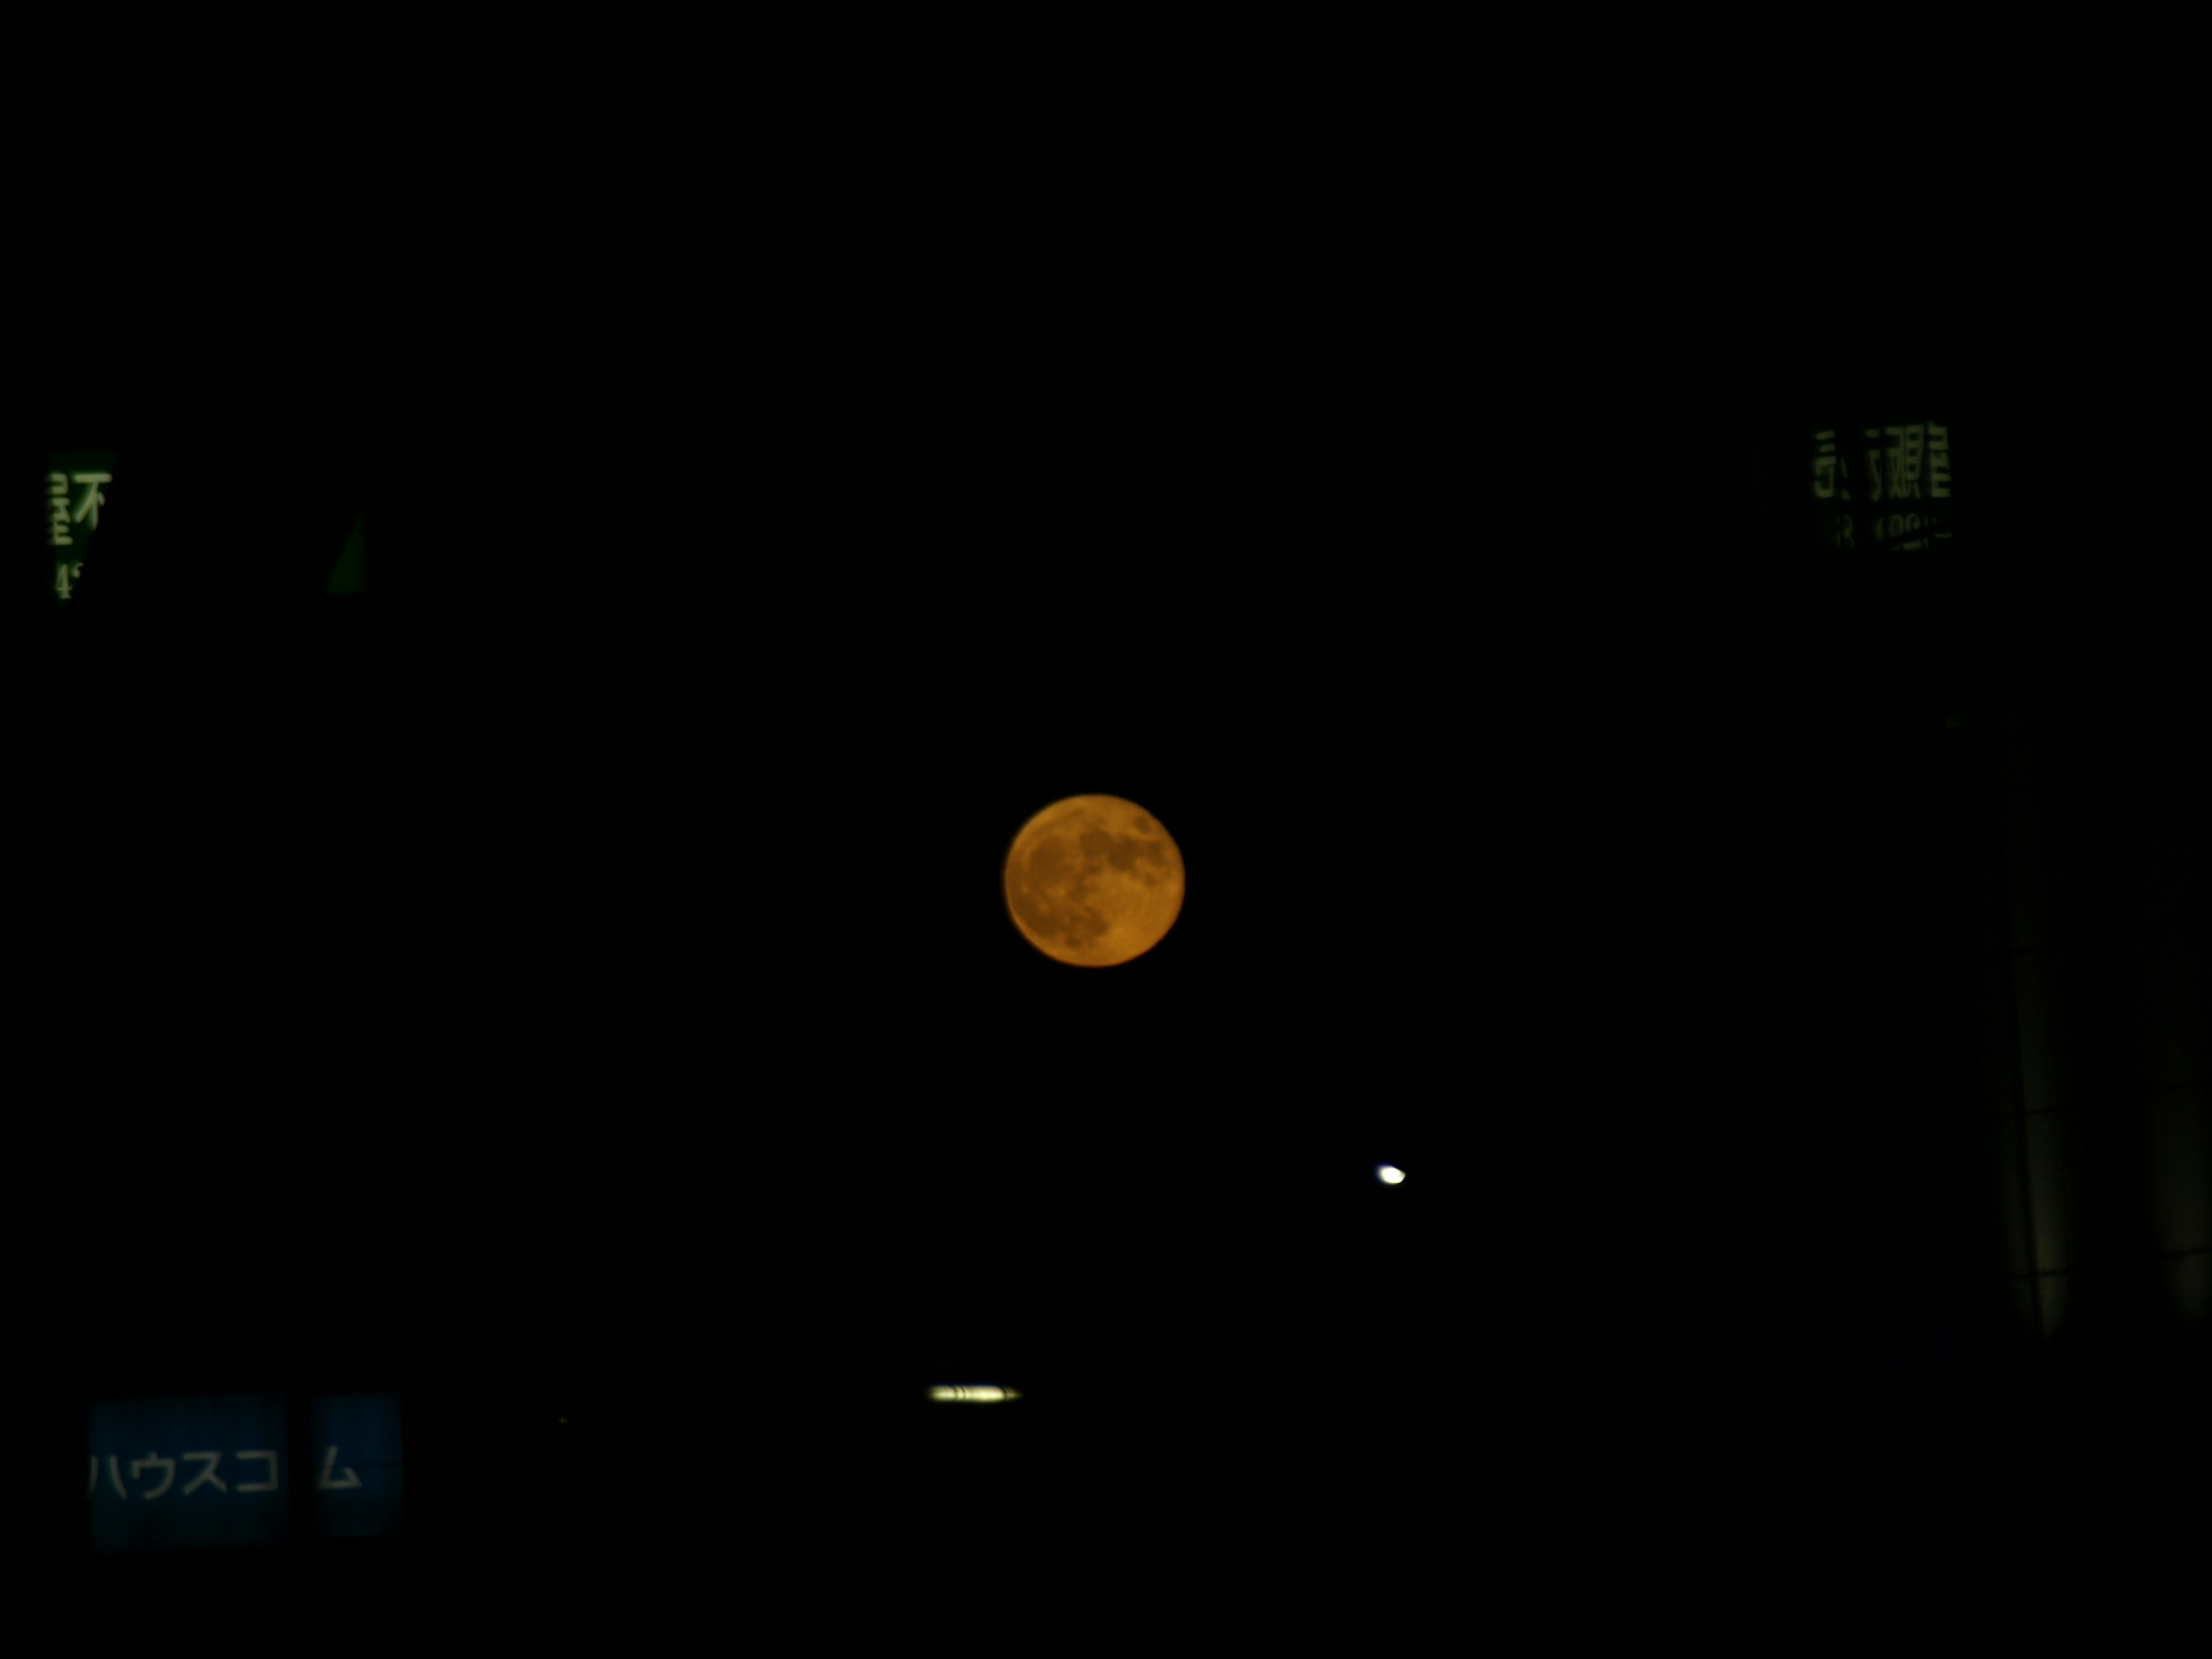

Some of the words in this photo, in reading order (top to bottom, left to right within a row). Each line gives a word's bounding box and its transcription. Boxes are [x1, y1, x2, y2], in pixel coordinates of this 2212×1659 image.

[86, 1444, 364, 1501] ハウスコム
